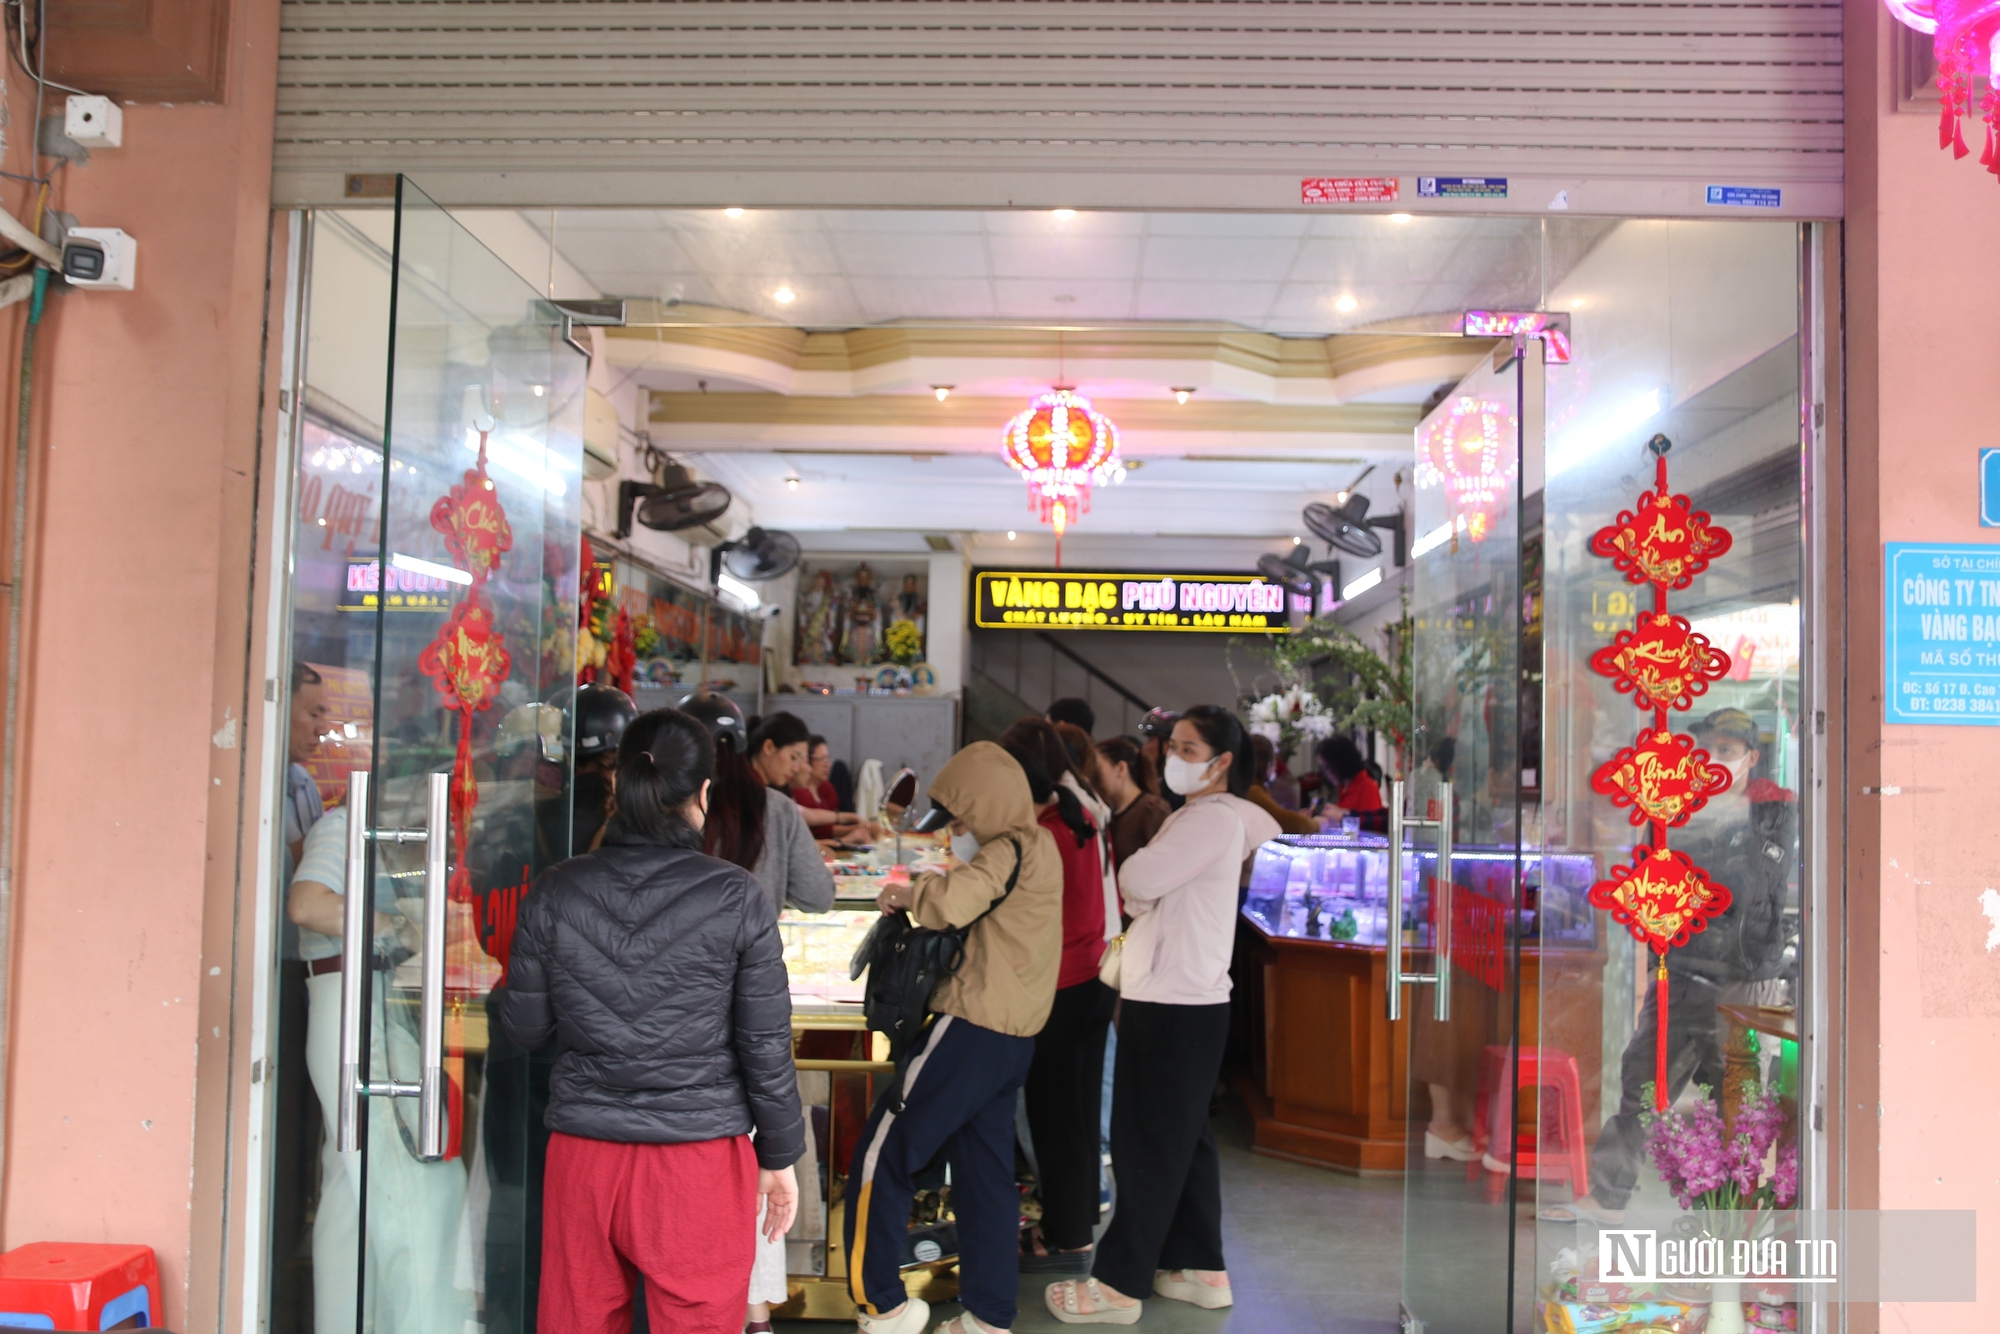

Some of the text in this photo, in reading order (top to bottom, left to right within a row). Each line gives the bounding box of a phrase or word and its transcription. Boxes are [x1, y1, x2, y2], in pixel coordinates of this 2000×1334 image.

[1641, 514, 1685, 546] An
[1932, 555, 2000, 570] SỞ TÀI CHÍ
[990, 576, 1284, 614] VÀNG BẠC PHÚ NGUYÊN
[1903, 573, 1950, 606] CÔNG
[1954, 579, 1975, 607] TY
[1921, 608, 1967, 641] VÀNG
[1635, 639, 1693, 676] Khang
[1921, 647, 2000, 667] MÃ SỐ TH
[1903, 681, 1922, 695] ĐC:
[1925, 681, 1940, 695] Số
[1943, 683, 1957, 695] 17
[1959, 683, 1971, 696] Đ.
[1974, 684, 1996, 696] Cao
[1910, 697, 1930, 711] ĐT:
[1933, 697, 1966, 712] 0238
